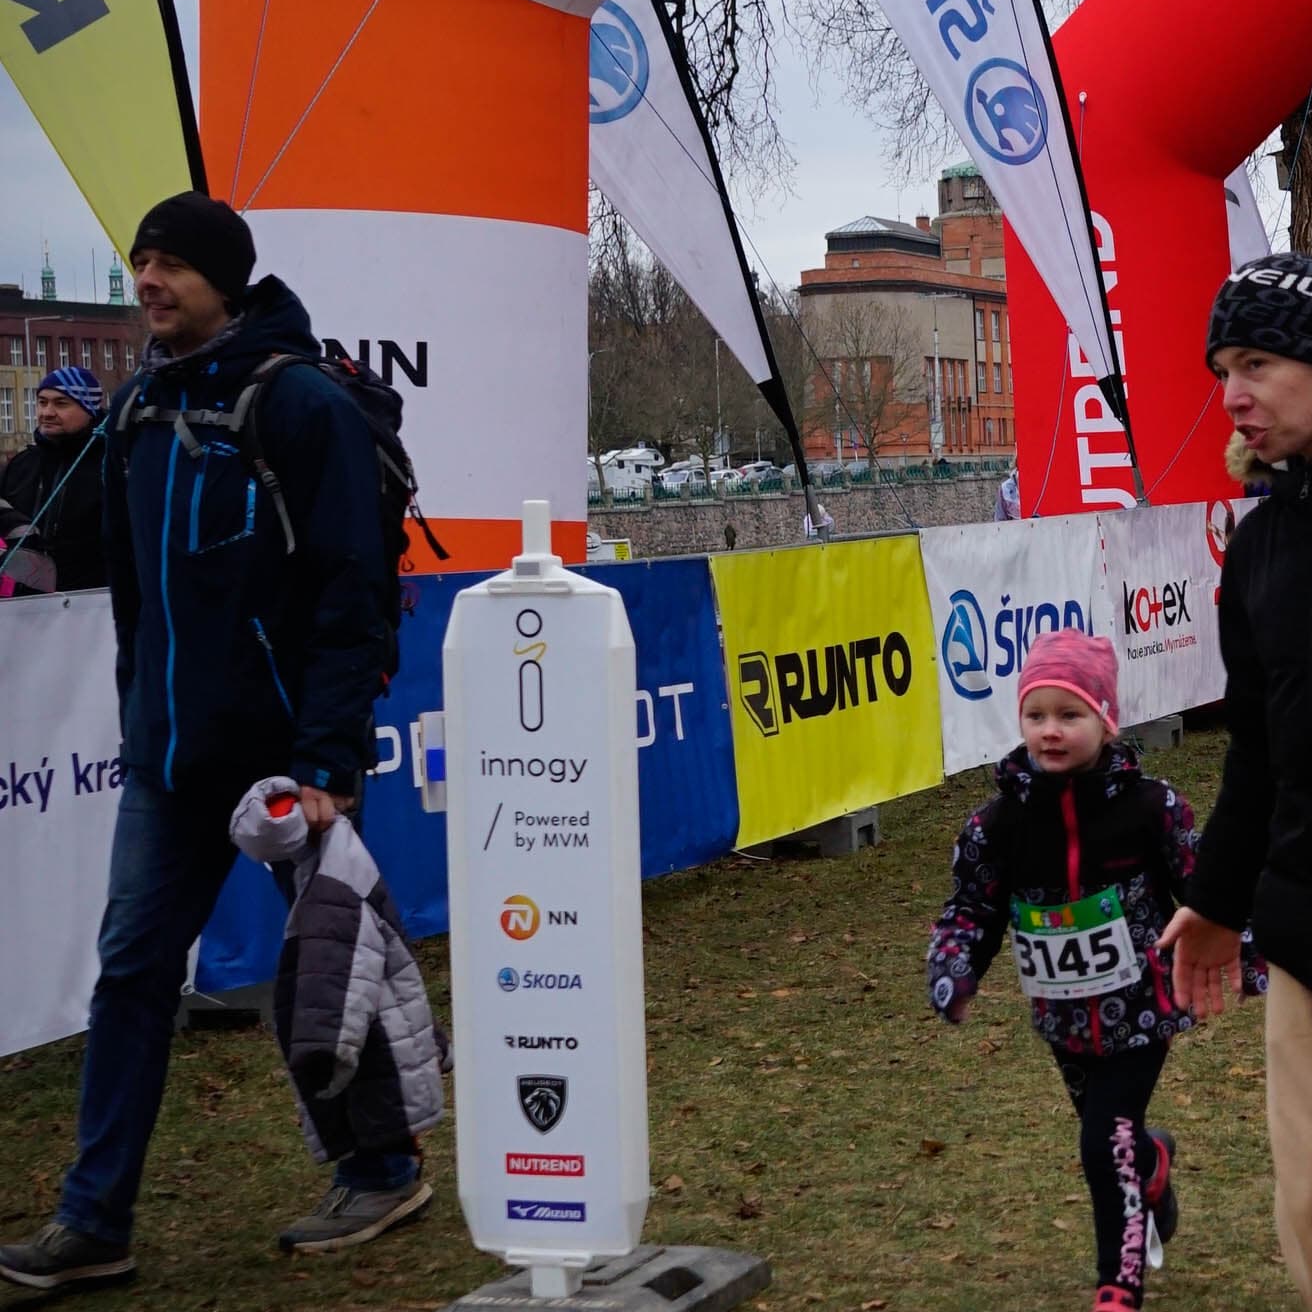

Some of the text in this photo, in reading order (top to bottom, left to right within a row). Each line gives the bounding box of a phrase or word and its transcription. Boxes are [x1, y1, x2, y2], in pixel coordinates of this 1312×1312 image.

[1123, 580, 1191, 635] kotex
[775, 631, 912, 724] RUNTO
[480, 750, 588, 783] innogy
[514, 810, 590, 827] Powered
[514, 831, 590, 852] by MVM
[548, 910, 578, 926] NN
[1015, 927, 1120, 979] 3145
[522, 970, 583, 990] ŠKODA
[509, 1158, 582, 1172] NUTREND
